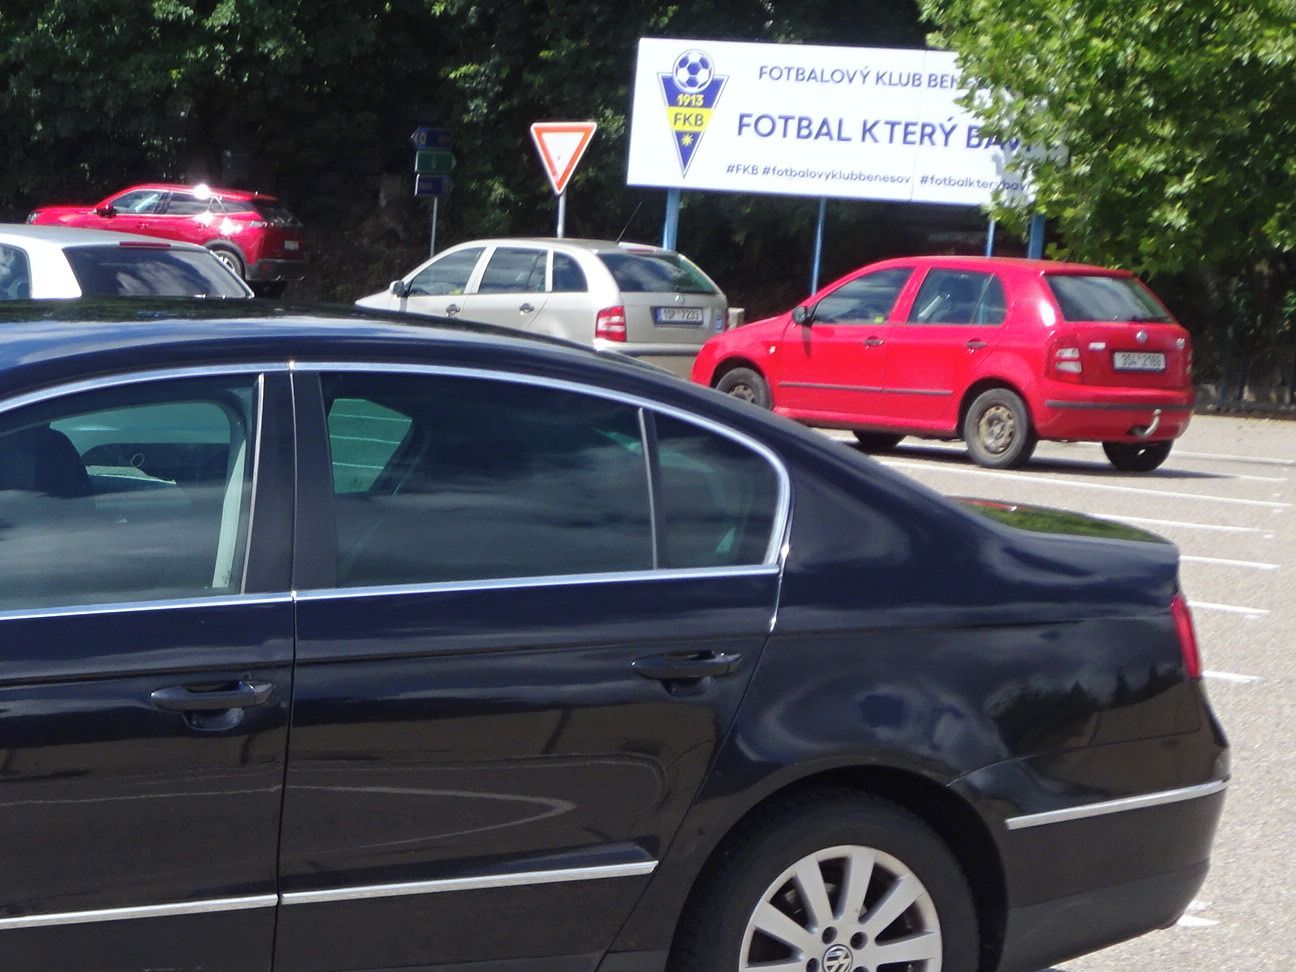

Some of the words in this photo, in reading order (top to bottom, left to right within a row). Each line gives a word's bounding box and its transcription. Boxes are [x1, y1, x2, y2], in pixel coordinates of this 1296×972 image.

[758, 65, 871, 86] FOTBALOVÝ
[875, 70, 923, 88] KLUB
[677, 93, 705, 107] 1913
[673, 112, 705, 127] FKB
[737, 112, 853, 142] FOTBAL
[861, 116, 958, 148] KTERÝ
[726, 163, 759, 176] #FKB
